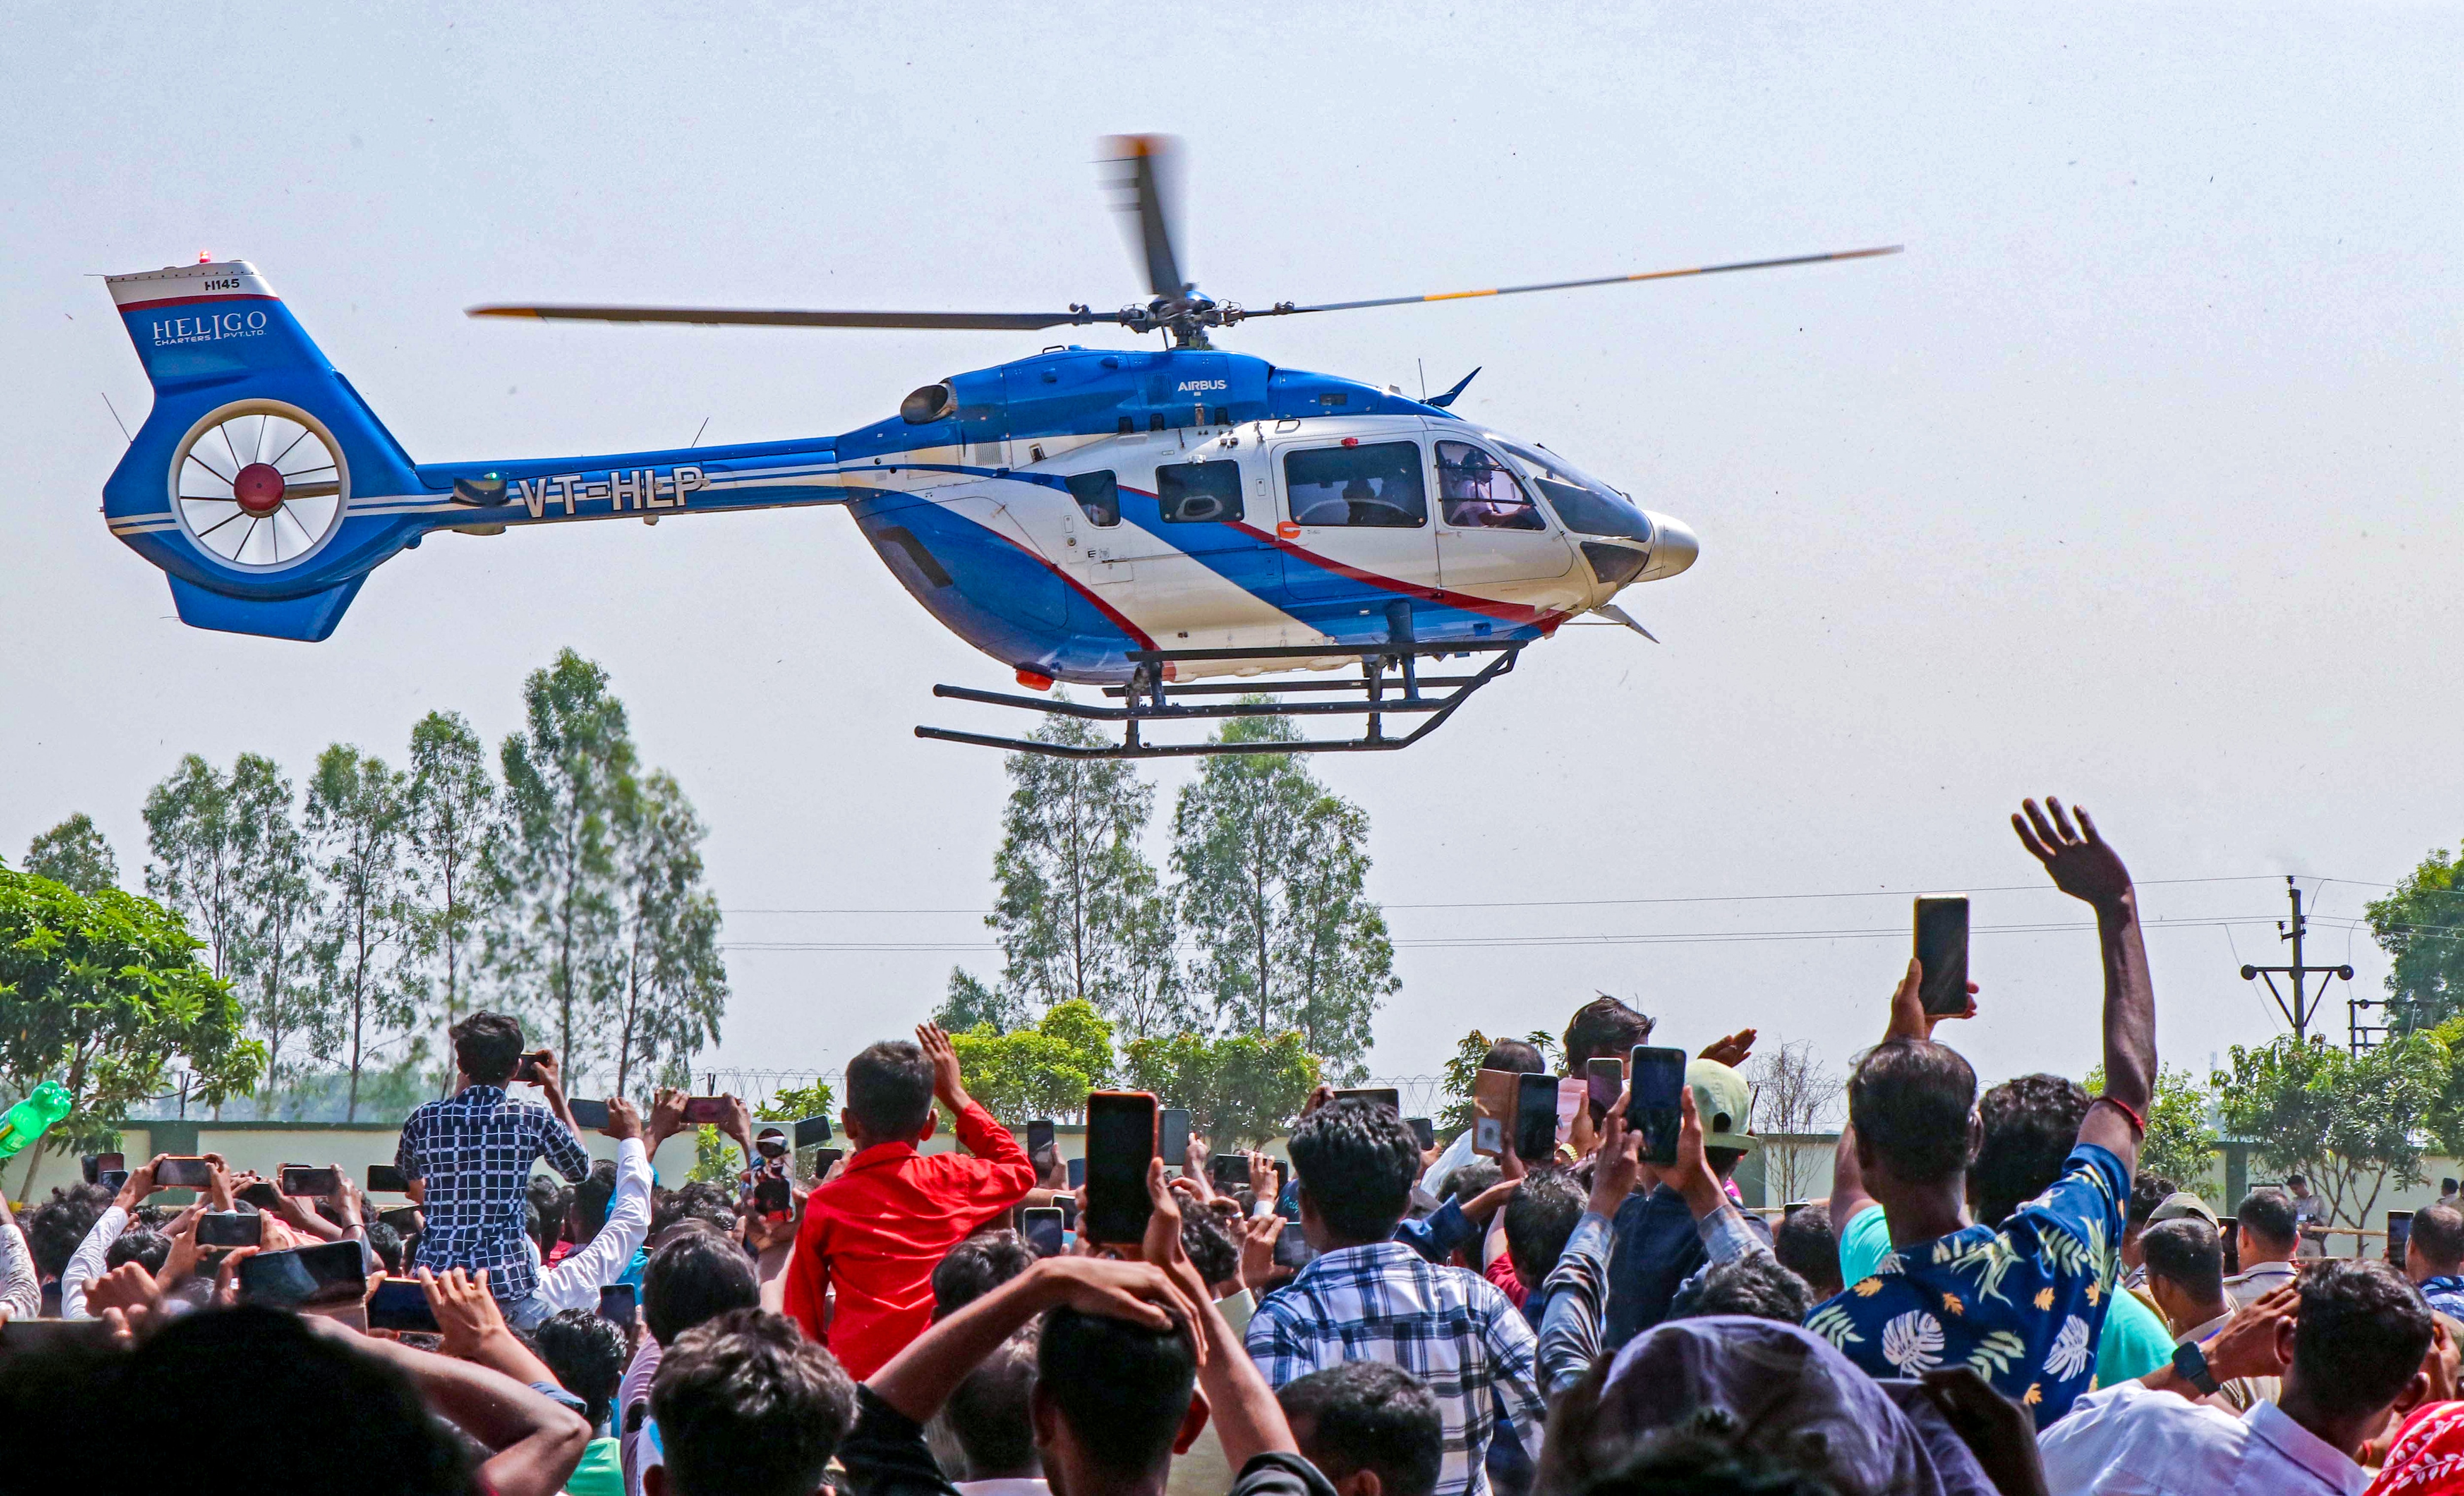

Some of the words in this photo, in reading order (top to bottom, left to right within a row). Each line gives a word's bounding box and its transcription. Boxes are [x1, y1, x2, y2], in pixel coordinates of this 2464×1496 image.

[205, 278, 240, 291] H145
[153, 311, 267, 340] HELIGO
[155, 335, 211, 347] CHARTERS
[1177, 380, 1228, 392] AIRBUS
[517, 465, 705, 519] VT-HLP
